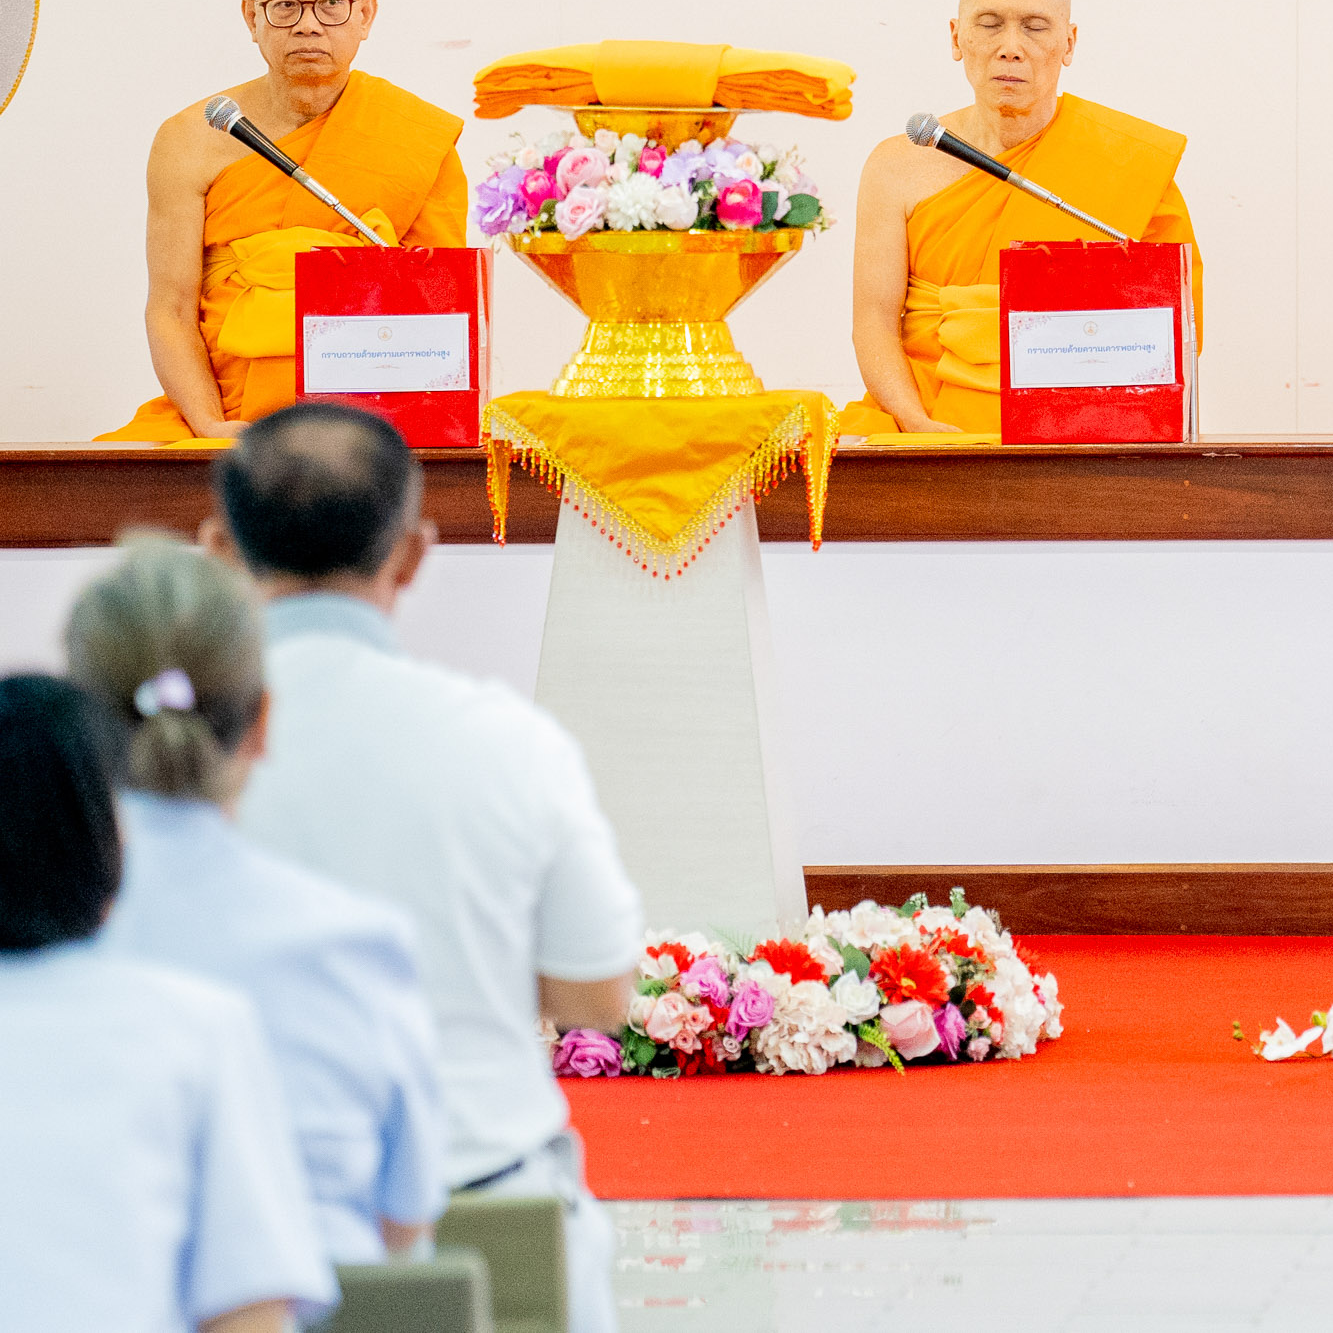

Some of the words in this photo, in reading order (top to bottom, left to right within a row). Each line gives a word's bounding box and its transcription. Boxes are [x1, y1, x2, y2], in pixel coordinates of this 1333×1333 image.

[321, 348, 452, 361] กราบถวายด้วยความเคารพอย่างสูง
